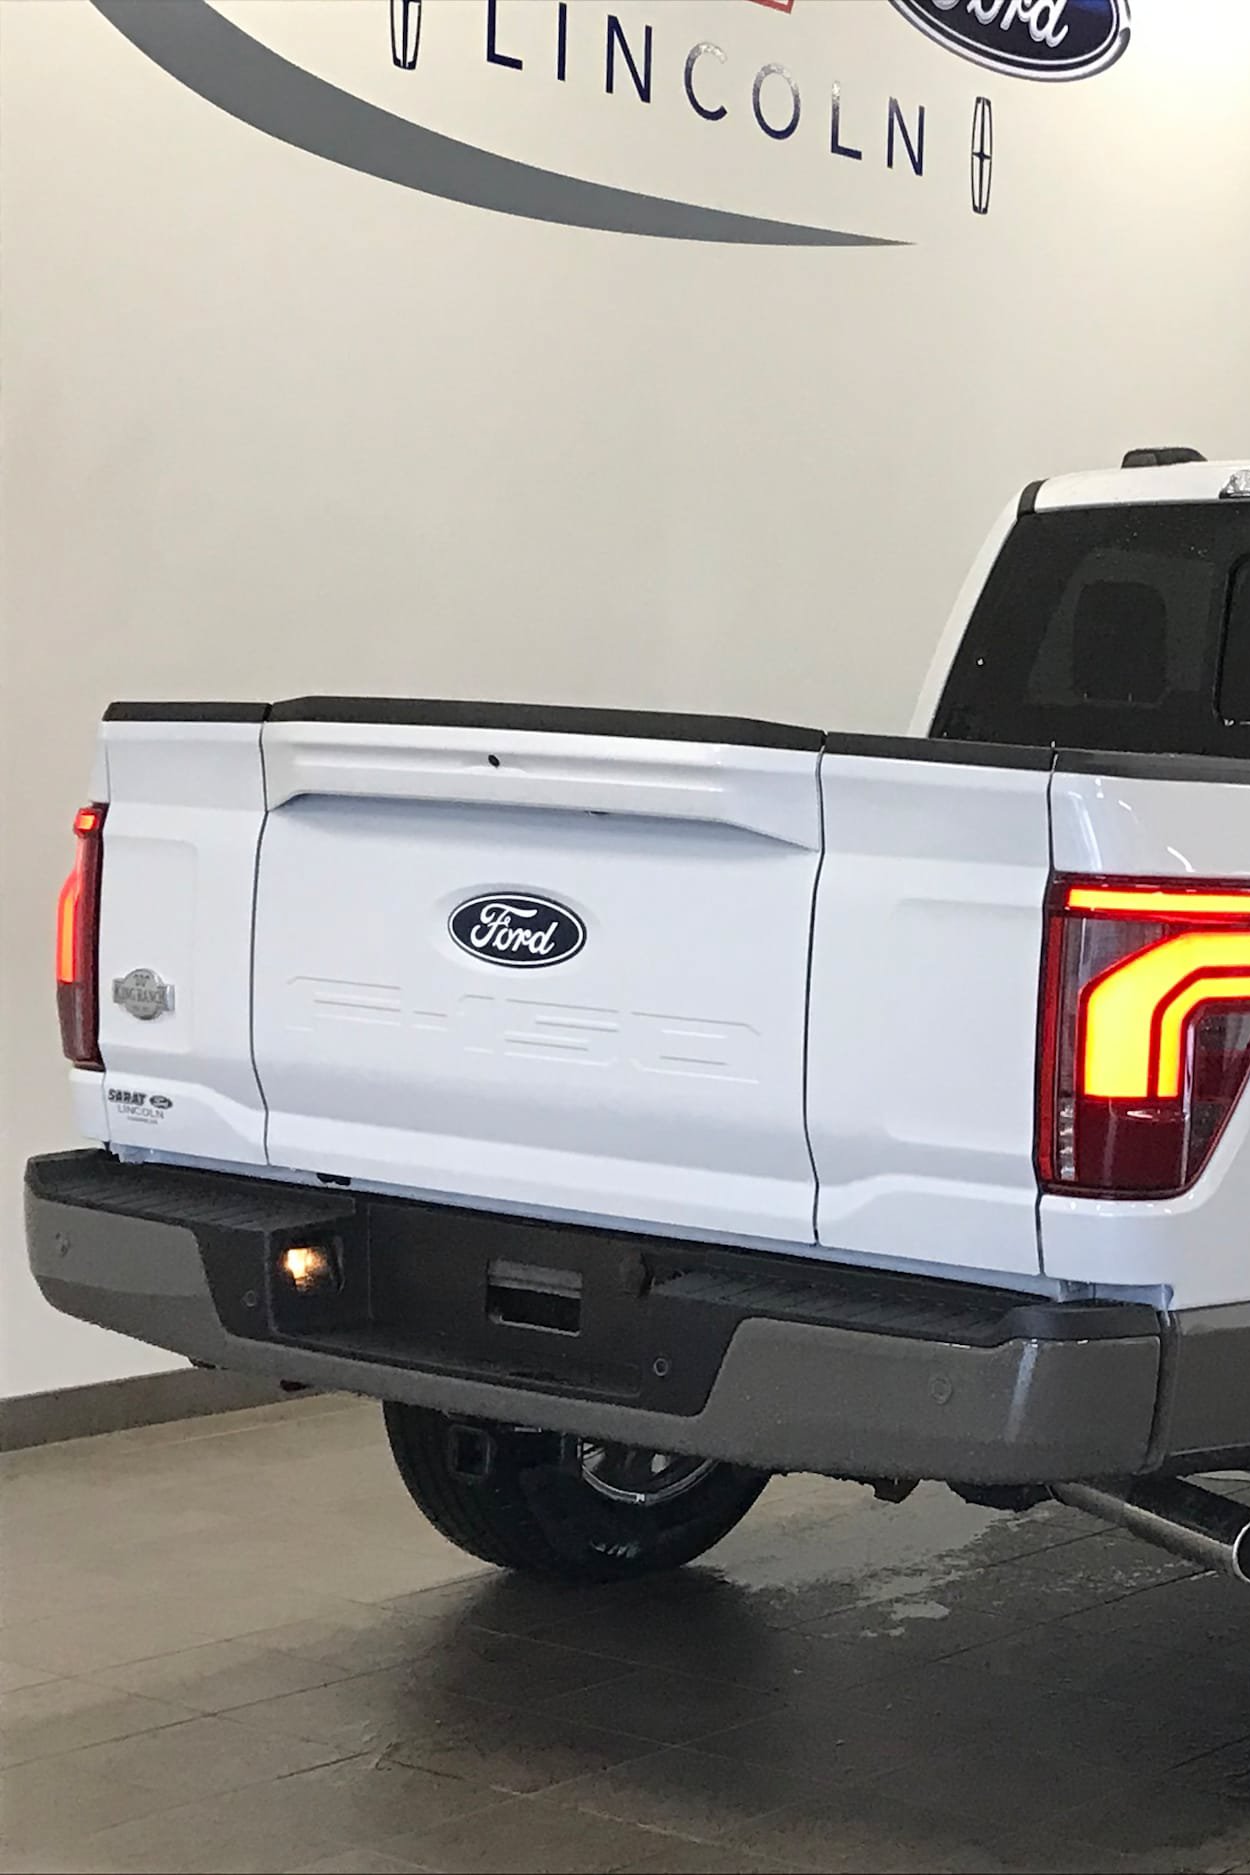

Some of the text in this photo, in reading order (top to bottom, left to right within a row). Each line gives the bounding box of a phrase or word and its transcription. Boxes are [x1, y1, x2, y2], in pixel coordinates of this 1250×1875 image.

[931, 0, 1069, 47] ord
[485, 0, 925, 177] LINCOLN
[470, 903, 559, 955] Ford
[117, 1104, 165, 1119] LINCOLN
